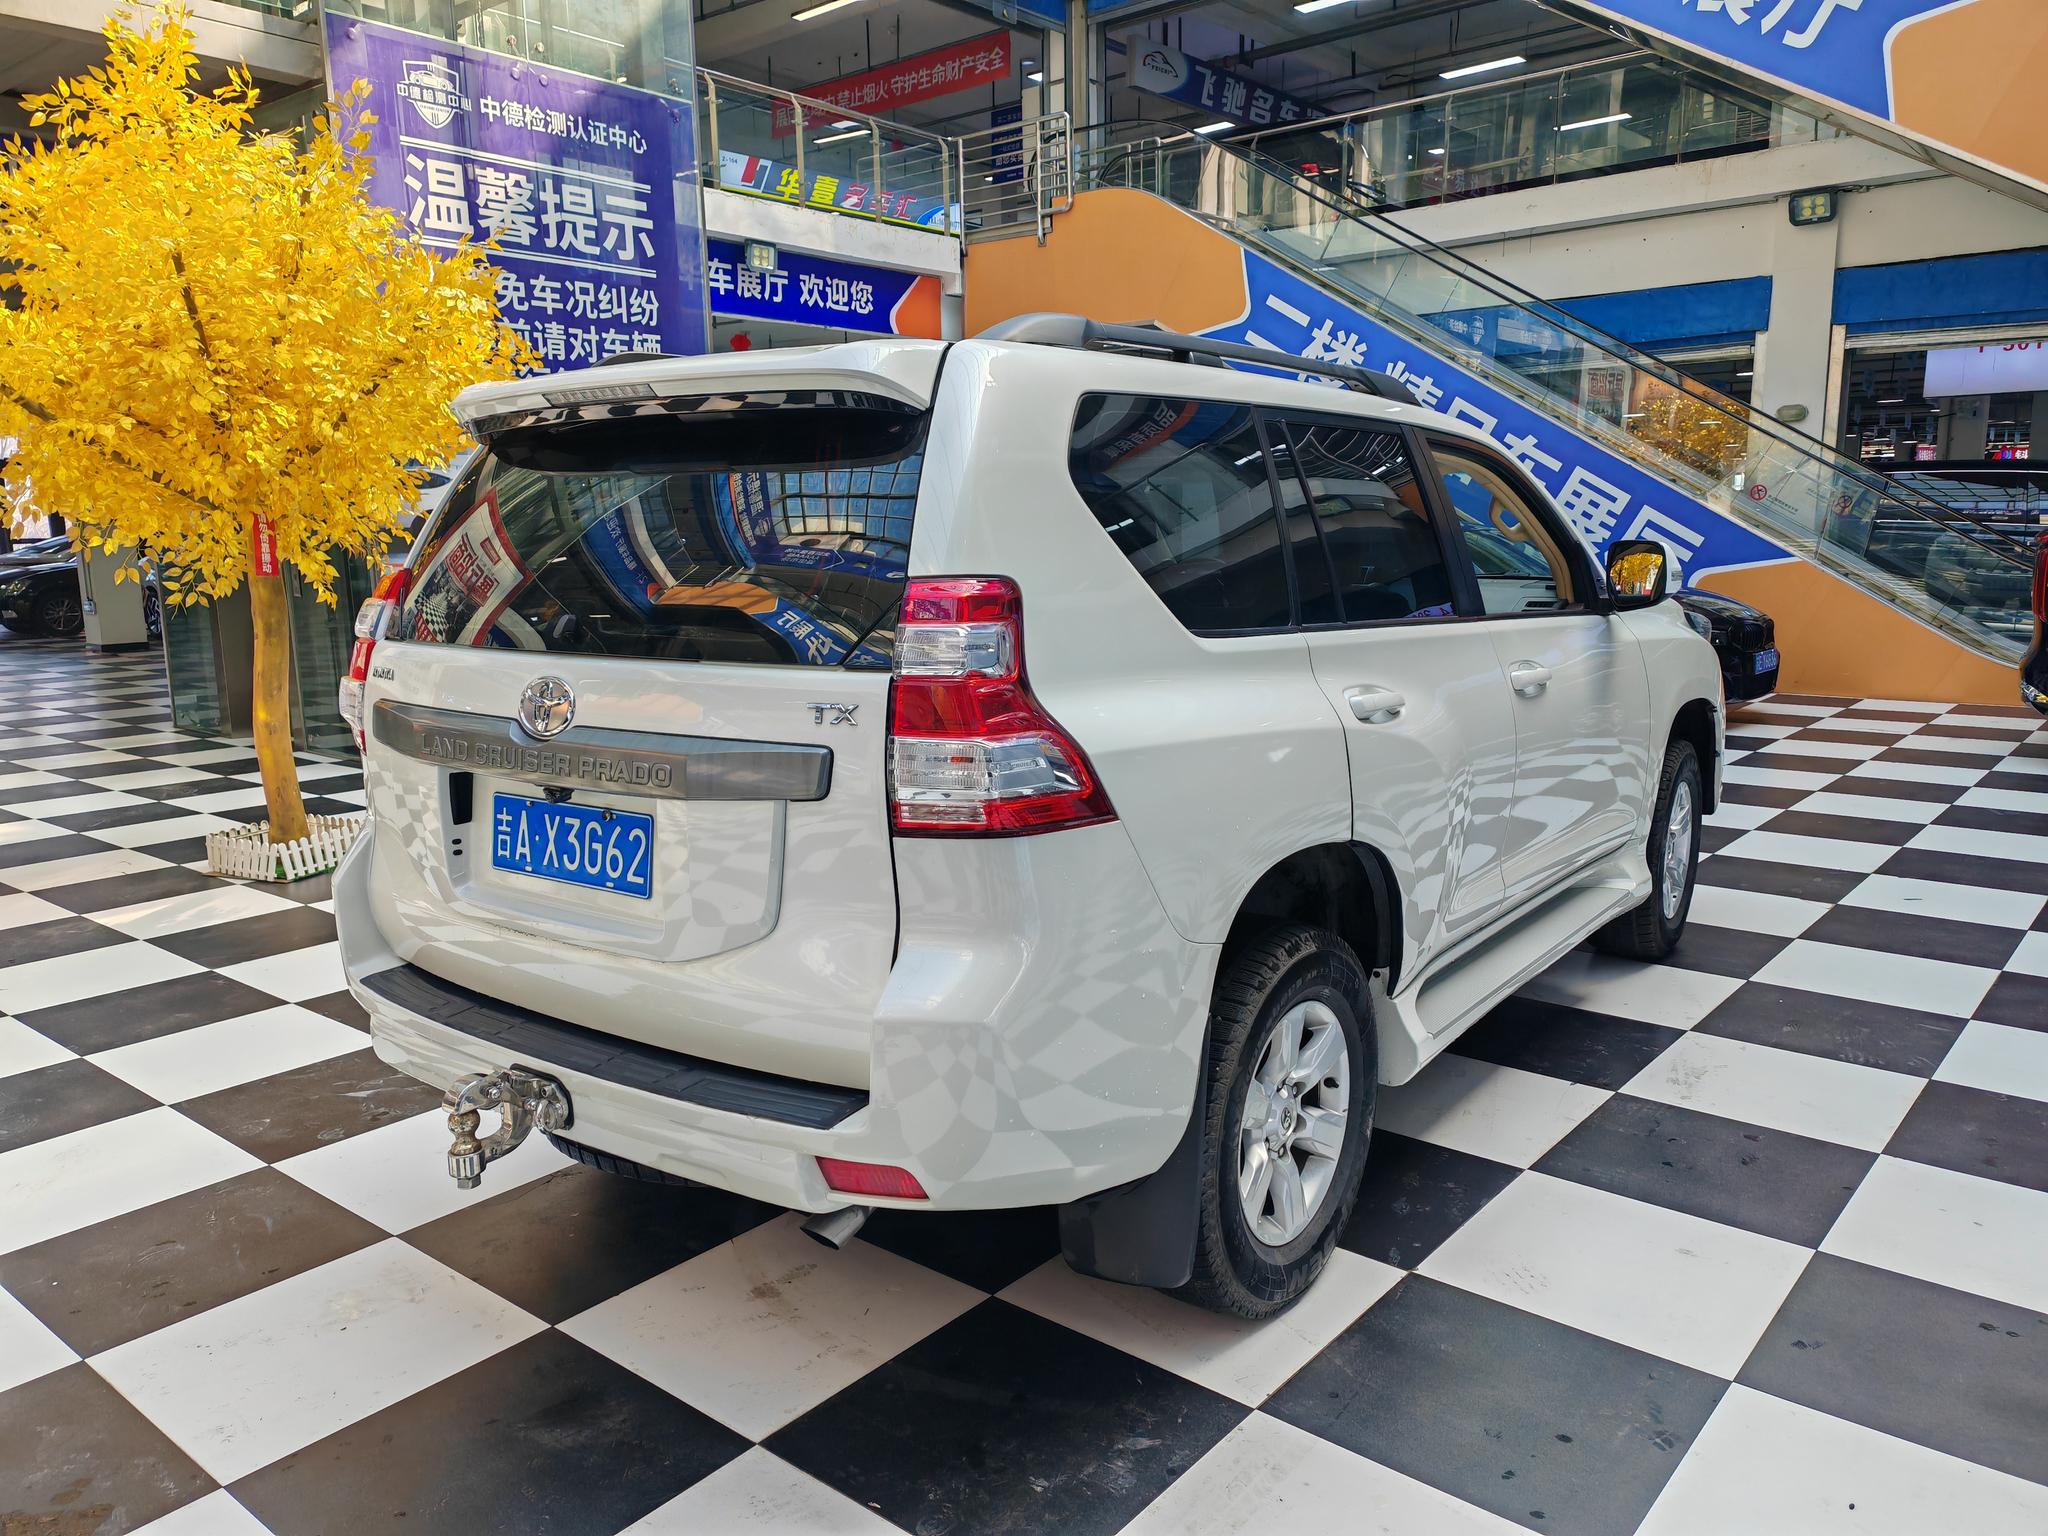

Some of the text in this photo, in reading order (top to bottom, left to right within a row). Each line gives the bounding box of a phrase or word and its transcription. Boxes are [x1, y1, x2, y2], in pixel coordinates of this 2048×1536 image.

[891, 46, 1005, 94] 守护生命财产安全
[479, 96, 648, 156] 中德检测认证中心
[403, 152, 656, 262] 温馨提示
[799, 273, 875, 315] 欢迎您
[806, 702, 860, 727] TX
[420, 733, 673, 789] LAND CRUISER PRADO
